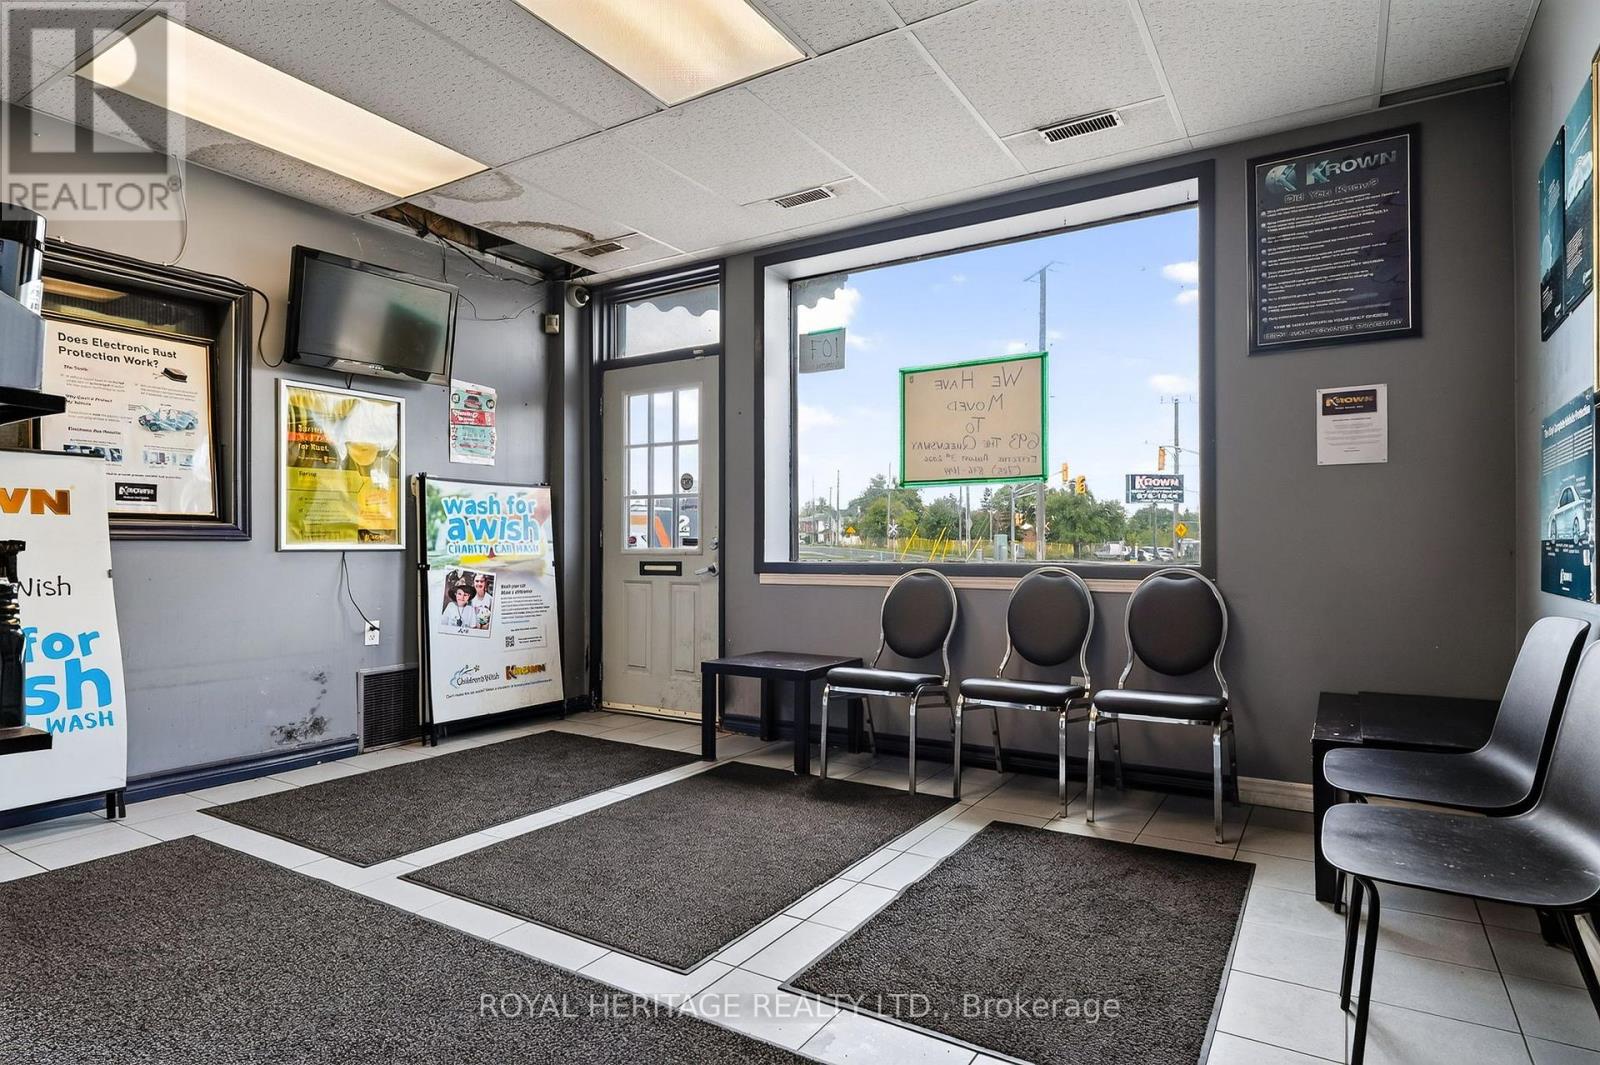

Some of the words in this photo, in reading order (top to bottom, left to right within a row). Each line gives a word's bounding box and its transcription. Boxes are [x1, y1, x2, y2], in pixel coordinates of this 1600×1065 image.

[58, 332, 89, 345] Does
[92, 337, 150, 355] Electronic
[152, 347, 177, 359] Rust
[58, 345, 121, 363] Protection
[123, 355, 159, 369] Work?
[443, 495, 501, 515] wash
[506, 495, 536, 515] for
[448, 544, 490, 554] CHARITY
[22, 626, 100, 663] for
[25, 658, 113, 716] sh
[45, 710, 114, 734] WASH
